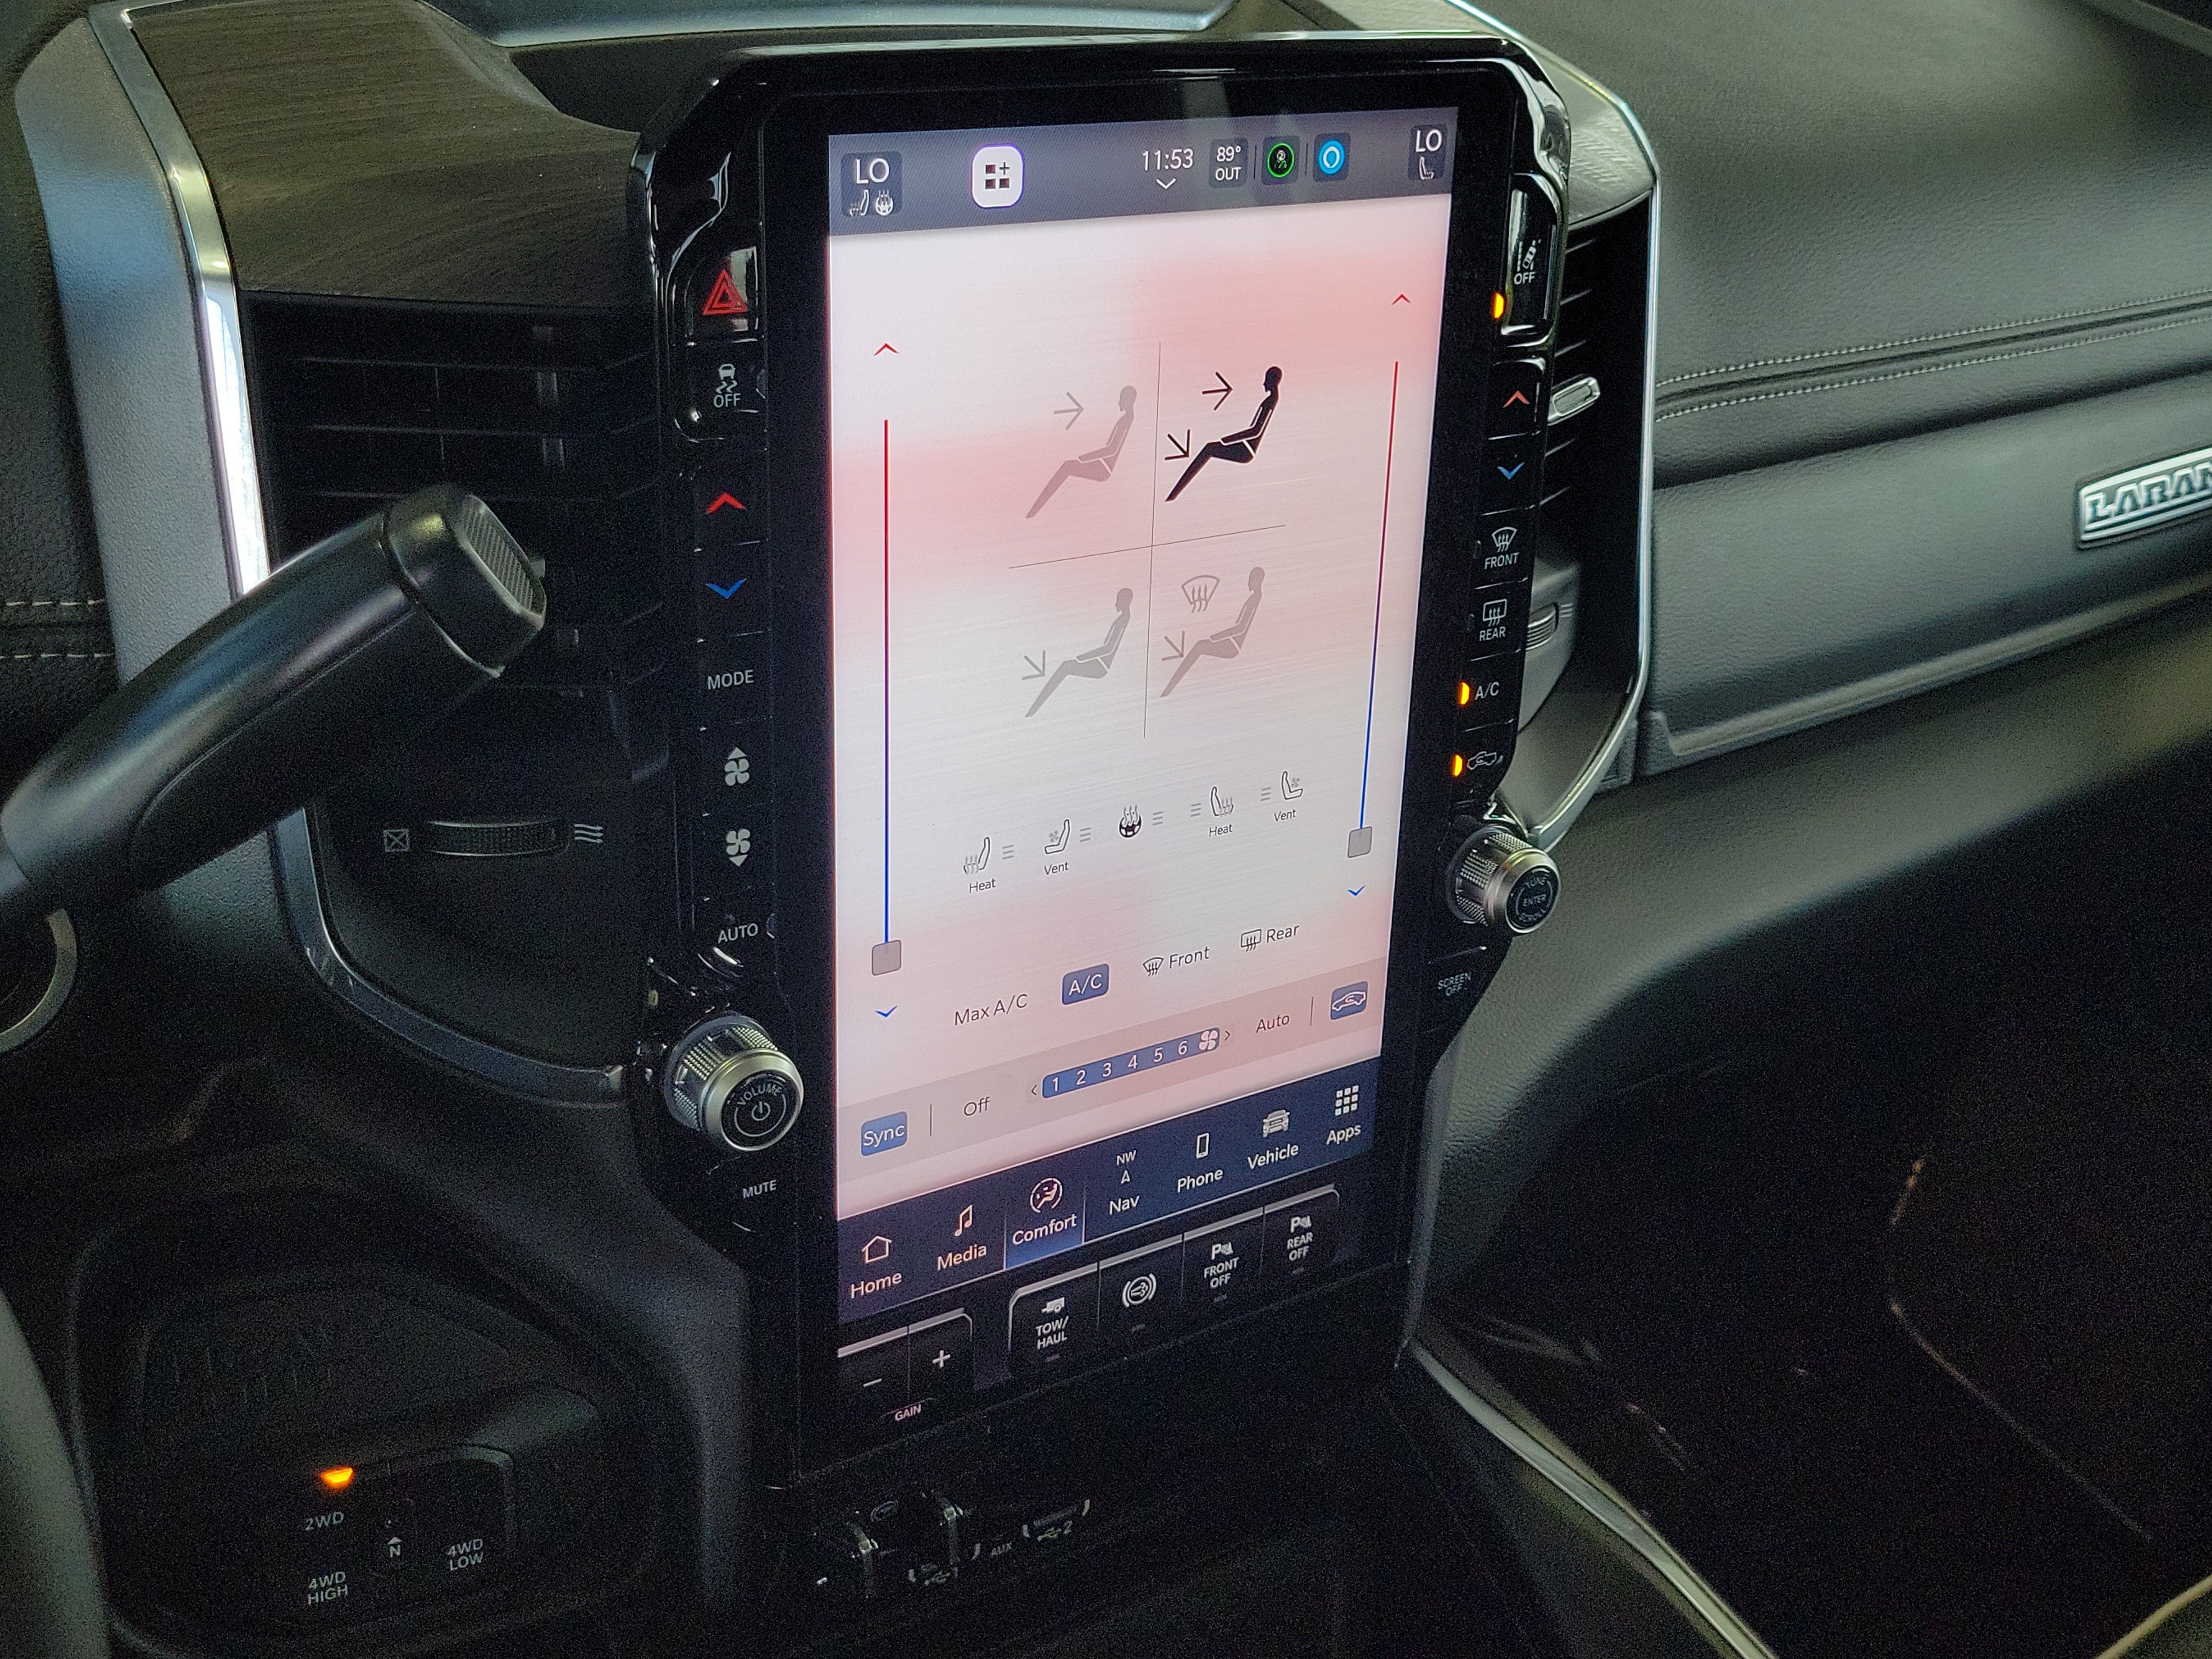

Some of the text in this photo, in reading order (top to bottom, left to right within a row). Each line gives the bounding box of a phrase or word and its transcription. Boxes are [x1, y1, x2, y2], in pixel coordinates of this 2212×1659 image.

[1415, 129, 1442, 153] LO
[1142, 149, 1194, 171] 11:53
[1216, 145, 1241, 162] 89°
[855, 158, 889, 184] LO
[1215, 167, 1241, 181] OUT
[1514, 272, 1535, 285] OFF
[714, 392, 741, 408] OFF
[1485, 552, 1519, 569] FRONT
[1480, 627, 1505, 641] REAR
[707, 669, 754, 690] MODE
[1475, 681, 1499, 700] A/C
[1273, 807, 1296, 822] Vent
[1209, 823, 1233, 837] Heat
[1044, 860, 1069, 875] Vent
[969, 878, 996, 893] Heat
[718, 923, 758, 944] AUTO
[1267, 924, 1300, 943] Rear
[1169, 946, 1210, 969] Front
[1068, 973, 1103, 996] A/C
[1437, 972, 1471, 990] SCREEN
[1446, 984, 1468, 996] OFF
[955, 994, 1028, 1025] Max A/C
[1256, 1014, 1290, 1032] Auto
[1052, 1040, 1188, 1092] 1 2 3 4 5 6
[737, 1082, 786, 1106] VOLUME
[963, 1097, 990, 1116] Off
[863, 1123, 905, 1148] Sync
[1327, 1124, 1361, 1145] Apps
[1116, 1150, 1137, 1165] NW
[1247, 1143, 1299, 1169] Vehicle
[742, 1179, 777, 1200] MUTE
[1177, 1169, 1223, 1193] Phone
[1109, 1195, 1139, 1215] Nav
[1012, 1214, 1077, 1245] Comfort
[1286, 1232, 1313, 1250] REAR
[937, 1244, 987, 1271] Media
[1289, 1246, 1309, 1261] OFF
[1204, 1257, 1239, 1278] FRONT
[850, 1271, 902, 1299] Home
[1210, 1273, 1231, 1289] OFF
[1036, 1315, 1069, 1337] TOW/
[1037, 1330, 1067, 1350] HAUL
[895, 1404, 921, 1421] GAIN
[305, 1511, 345, 1532] 2WD
[390, 1545, 402, 1558] N
[447, 1538, 483, 1556] 4WD
[449, 1551, 484, 1571] LOW
[309, 1571, 346, 1590] 4WD
[307, 1583, 348, 1606] HIGH
